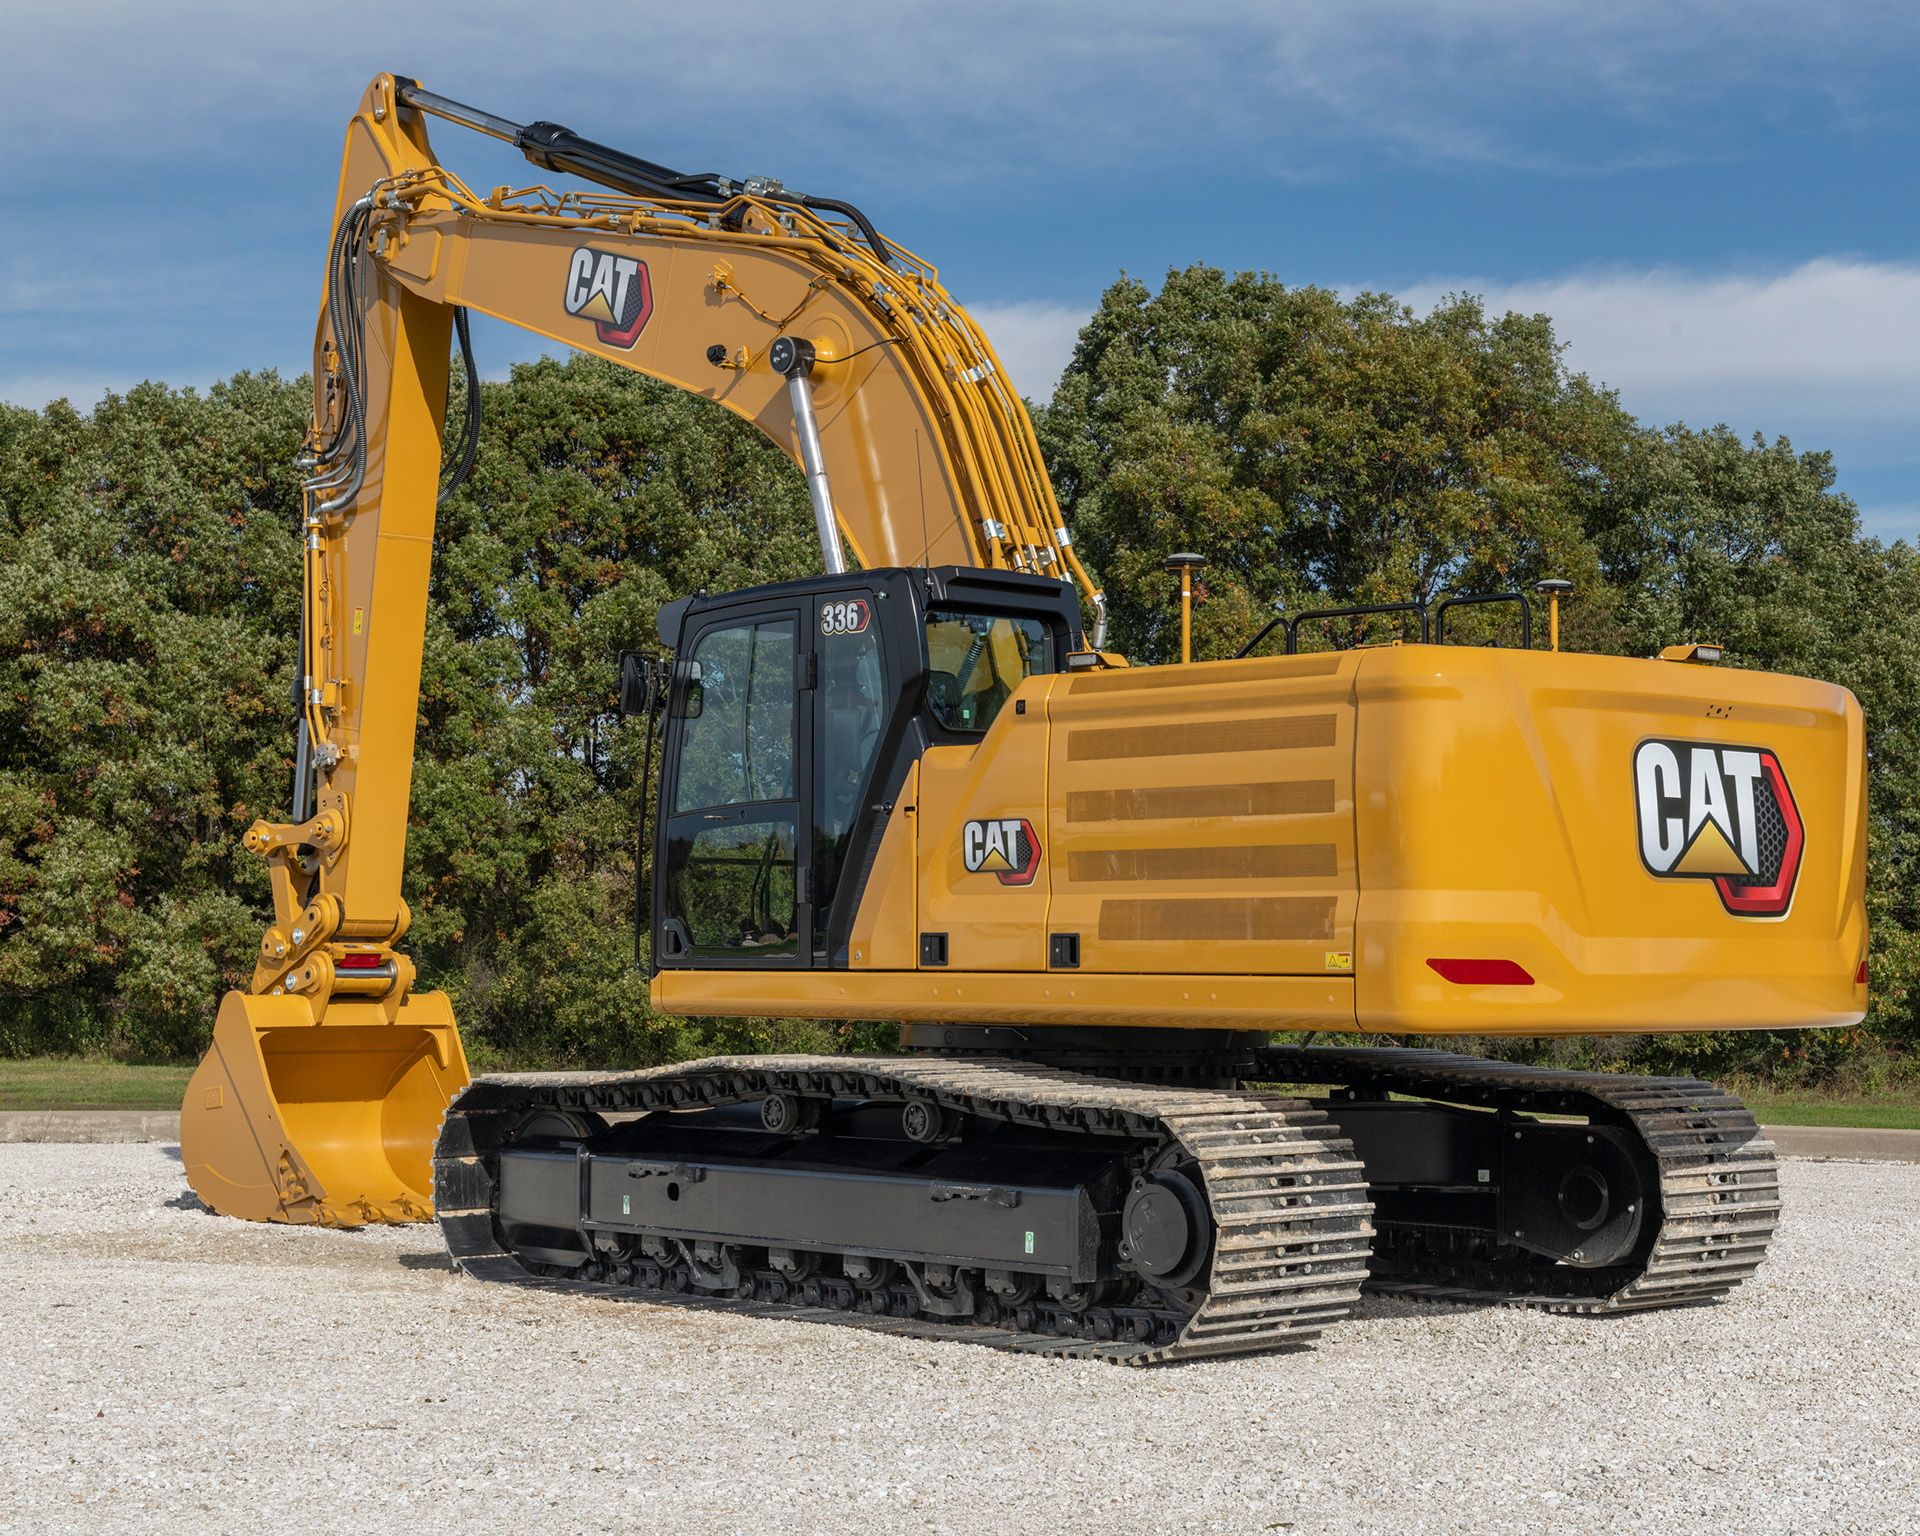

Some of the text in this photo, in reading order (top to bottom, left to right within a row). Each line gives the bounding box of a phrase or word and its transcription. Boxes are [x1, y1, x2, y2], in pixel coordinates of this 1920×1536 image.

[565, 248, 638, 325] CAT
[823, 602, 858, 632] 336
[1636, 742, 1762, 875] CAT
[964, 820, 1021, 871] CAT
